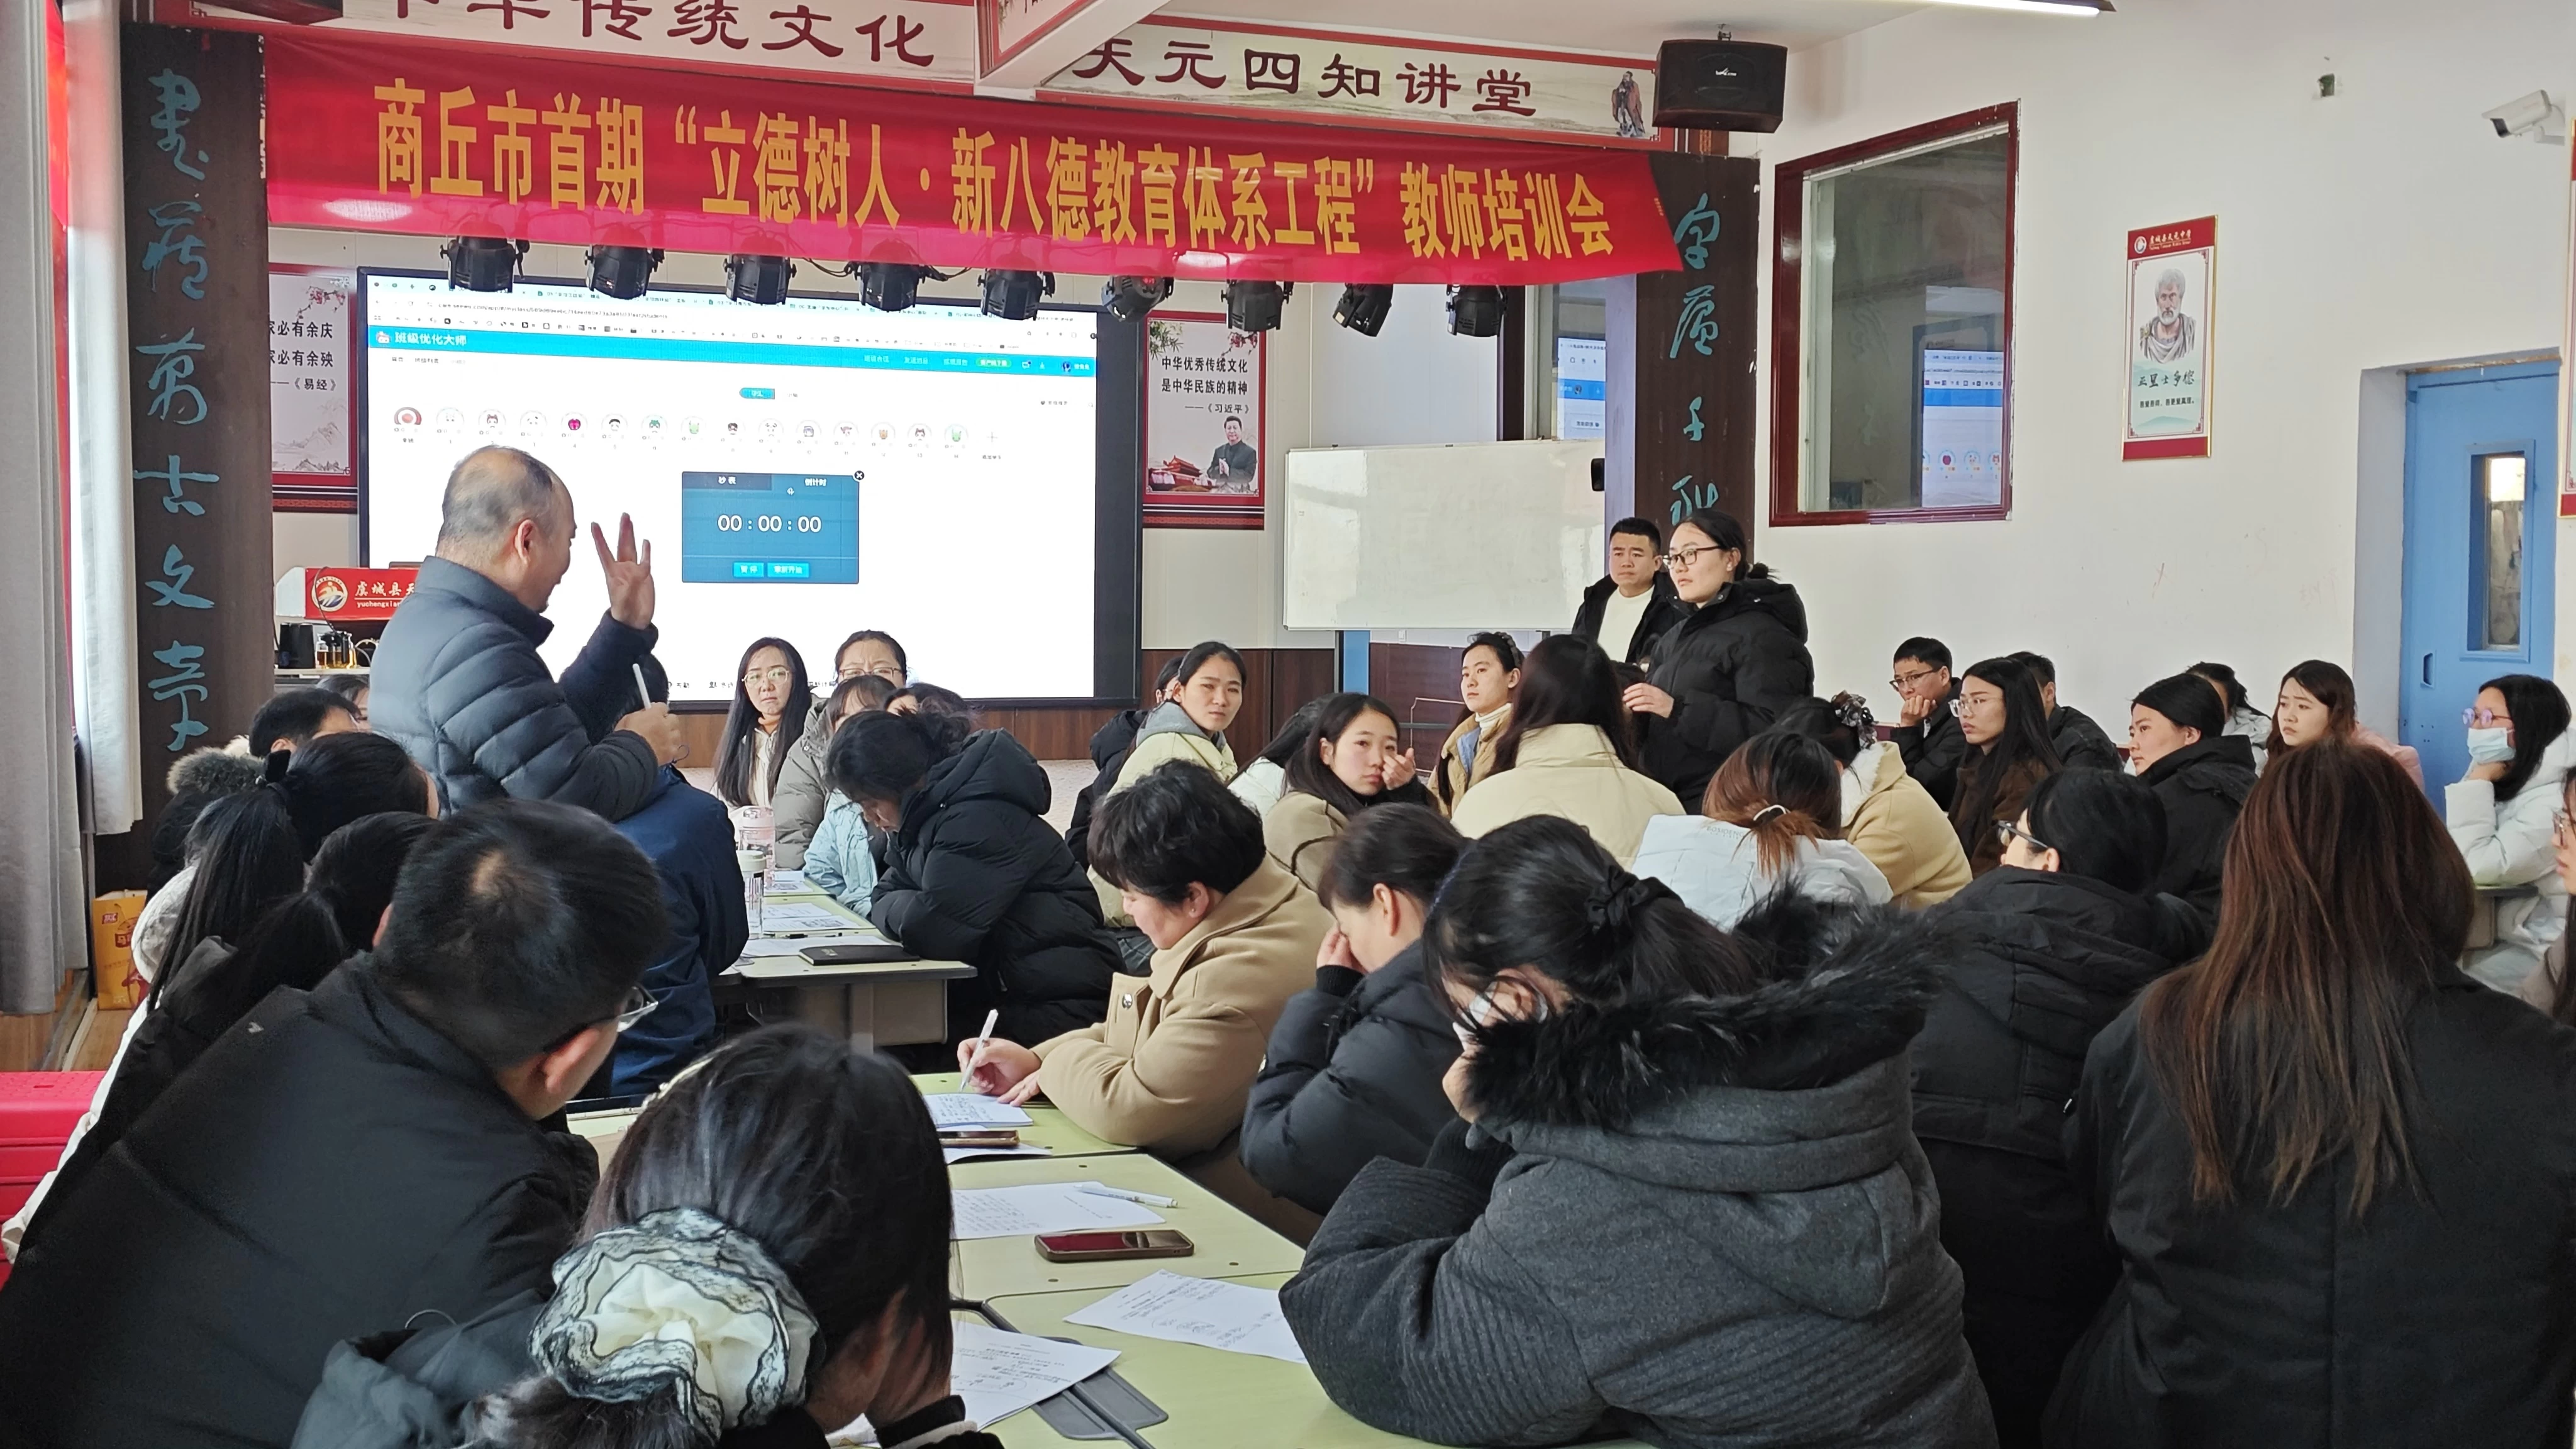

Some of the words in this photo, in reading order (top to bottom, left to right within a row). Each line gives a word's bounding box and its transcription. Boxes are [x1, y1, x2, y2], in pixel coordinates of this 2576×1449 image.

[396, 0, 935, 67] 传统文化
[1072, 38, 1536, 116] 天元四知讲堂
[394, 332, 467, 347] 班级优化大师
[1162, 356, 1248, 373] 中华优秀传统文化
[1162, 378, 1248, 396] 是中华民族的精神
